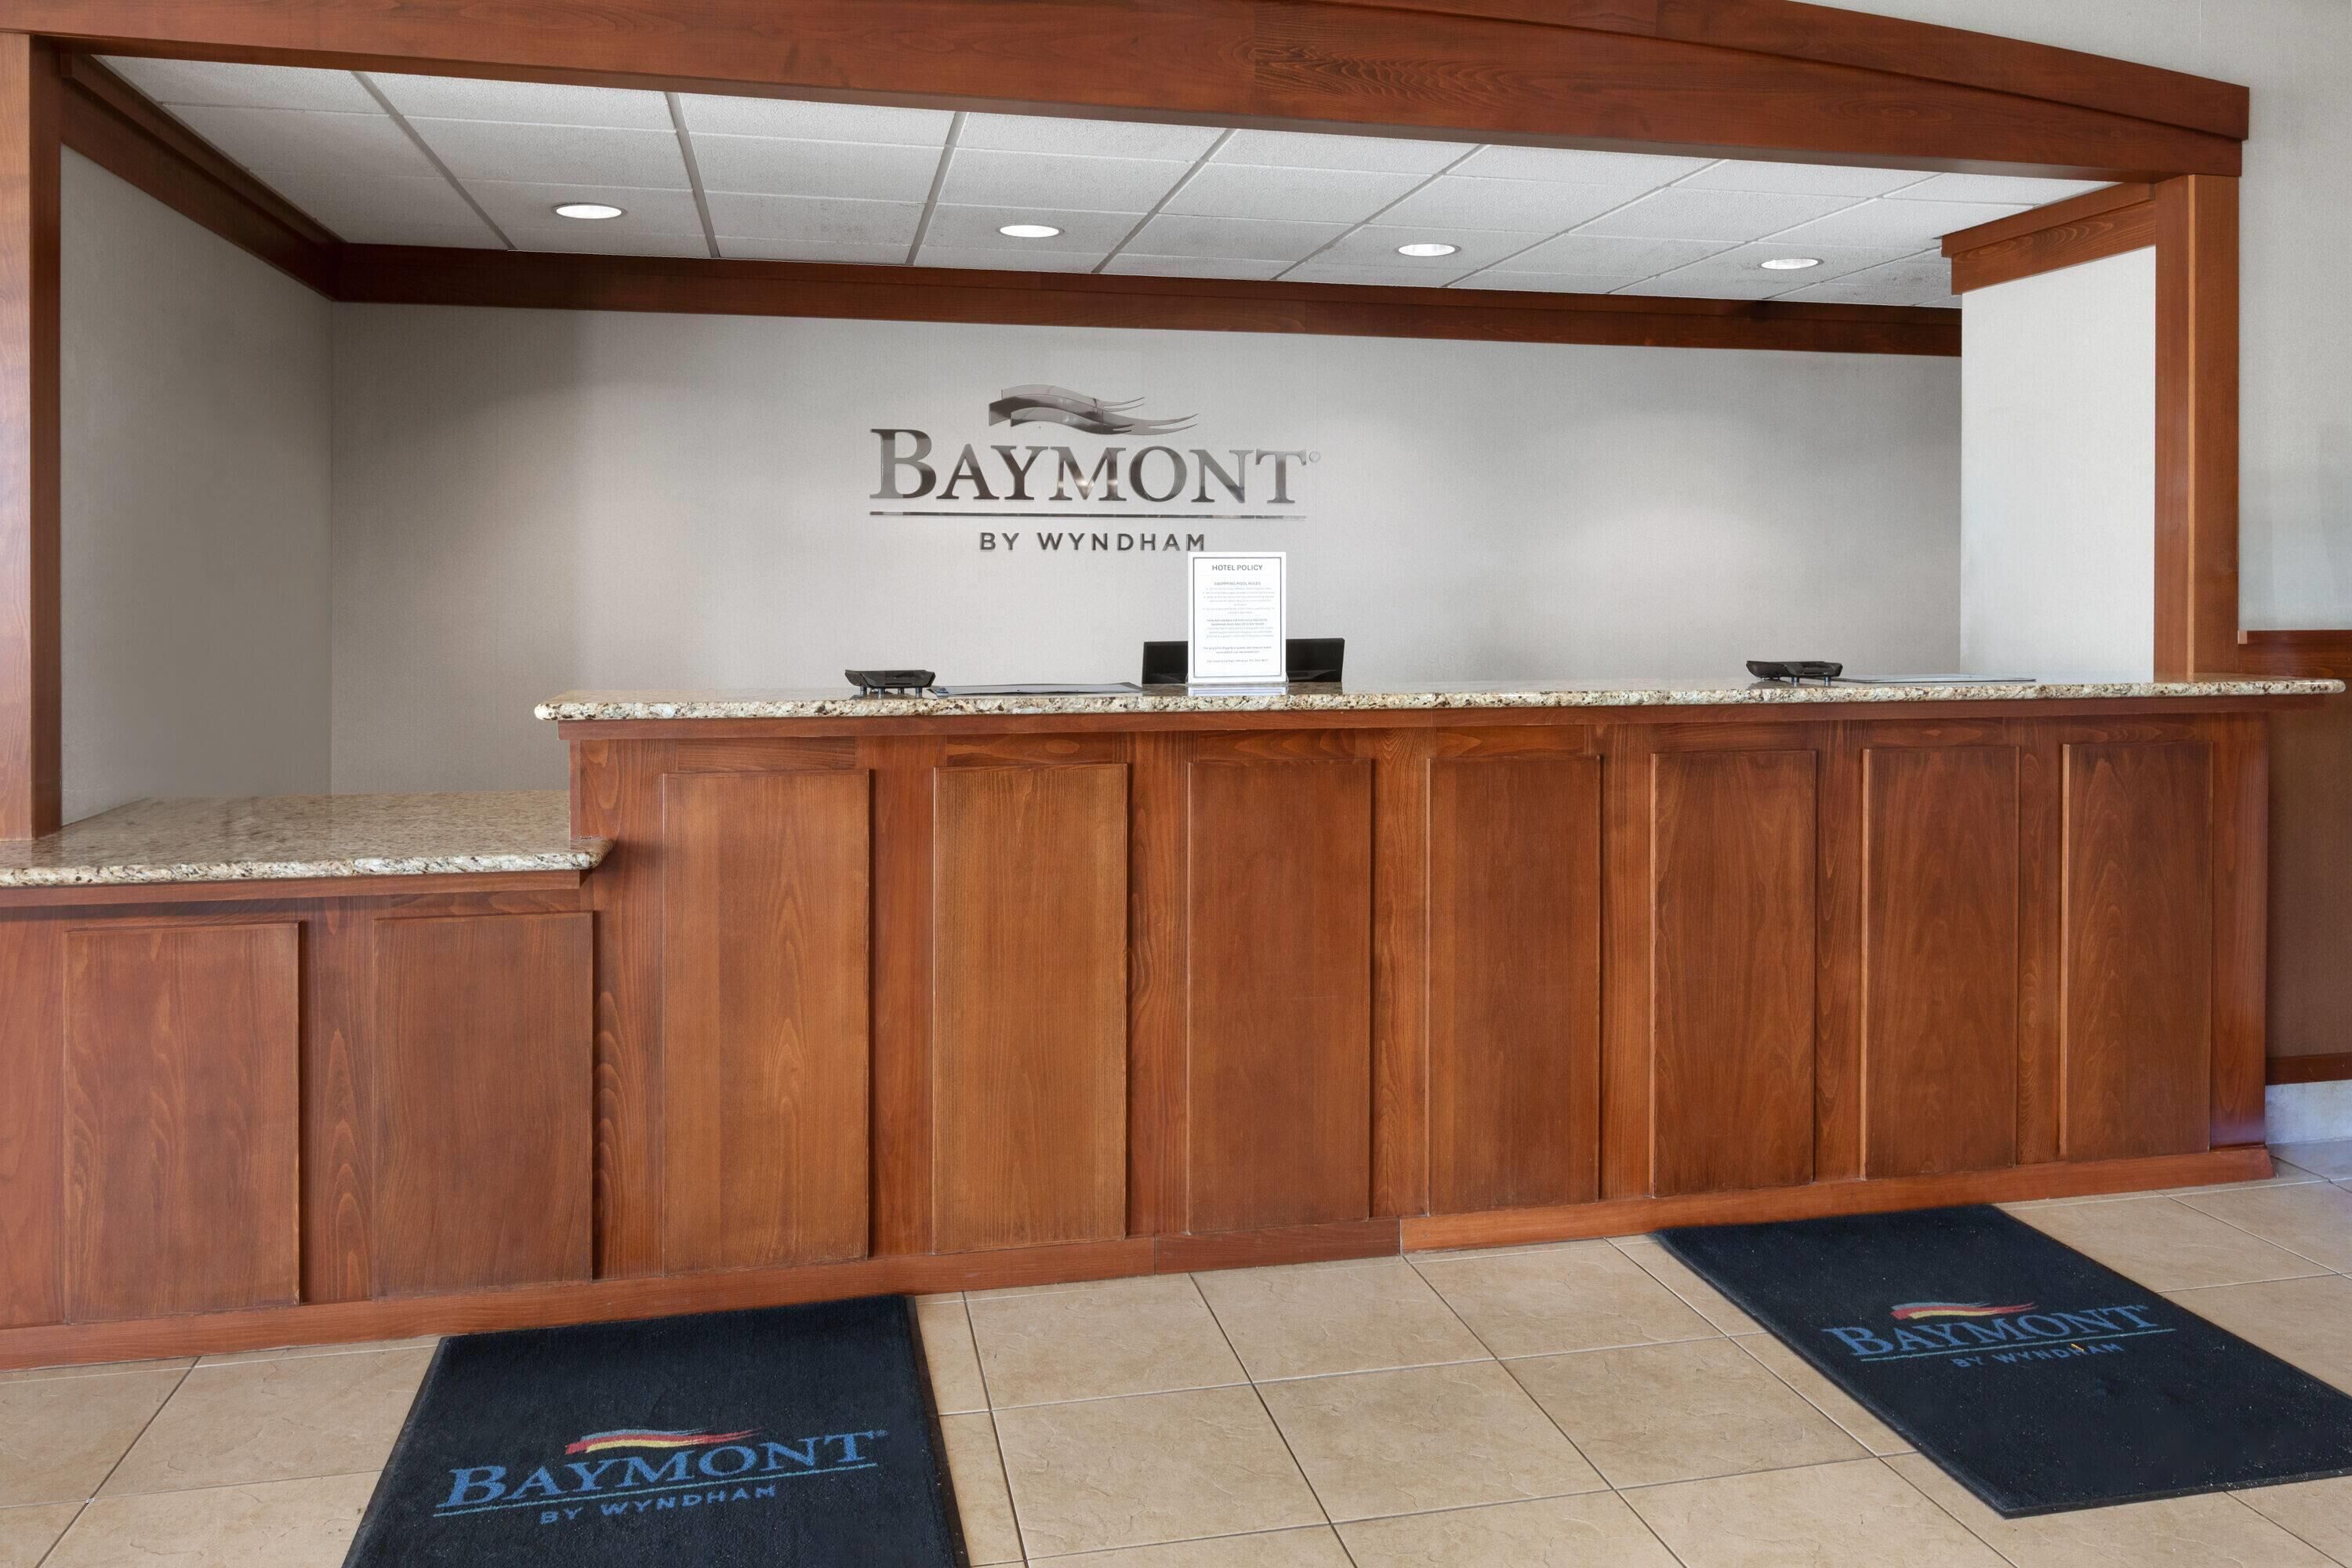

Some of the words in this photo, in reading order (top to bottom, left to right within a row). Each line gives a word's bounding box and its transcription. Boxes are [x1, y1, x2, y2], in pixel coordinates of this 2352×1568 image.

[869, 428, 1307, 503] BAYMONT
[979, 532, 1020, 551] BY
[1036, 532, 1206, 552] WYNDHAM
[1820, 1304, 2158, 1356] BAYMONT
[1951, 1357, 1982, 1368] BY
[1992, 1343, 2125, 1364] WYNDHAM
[436, 1429, 875, 1508] BAYMONT
[540, 1507, 583, 1525] BY
[601, 1484, 777, 1516] WYNDHAM
